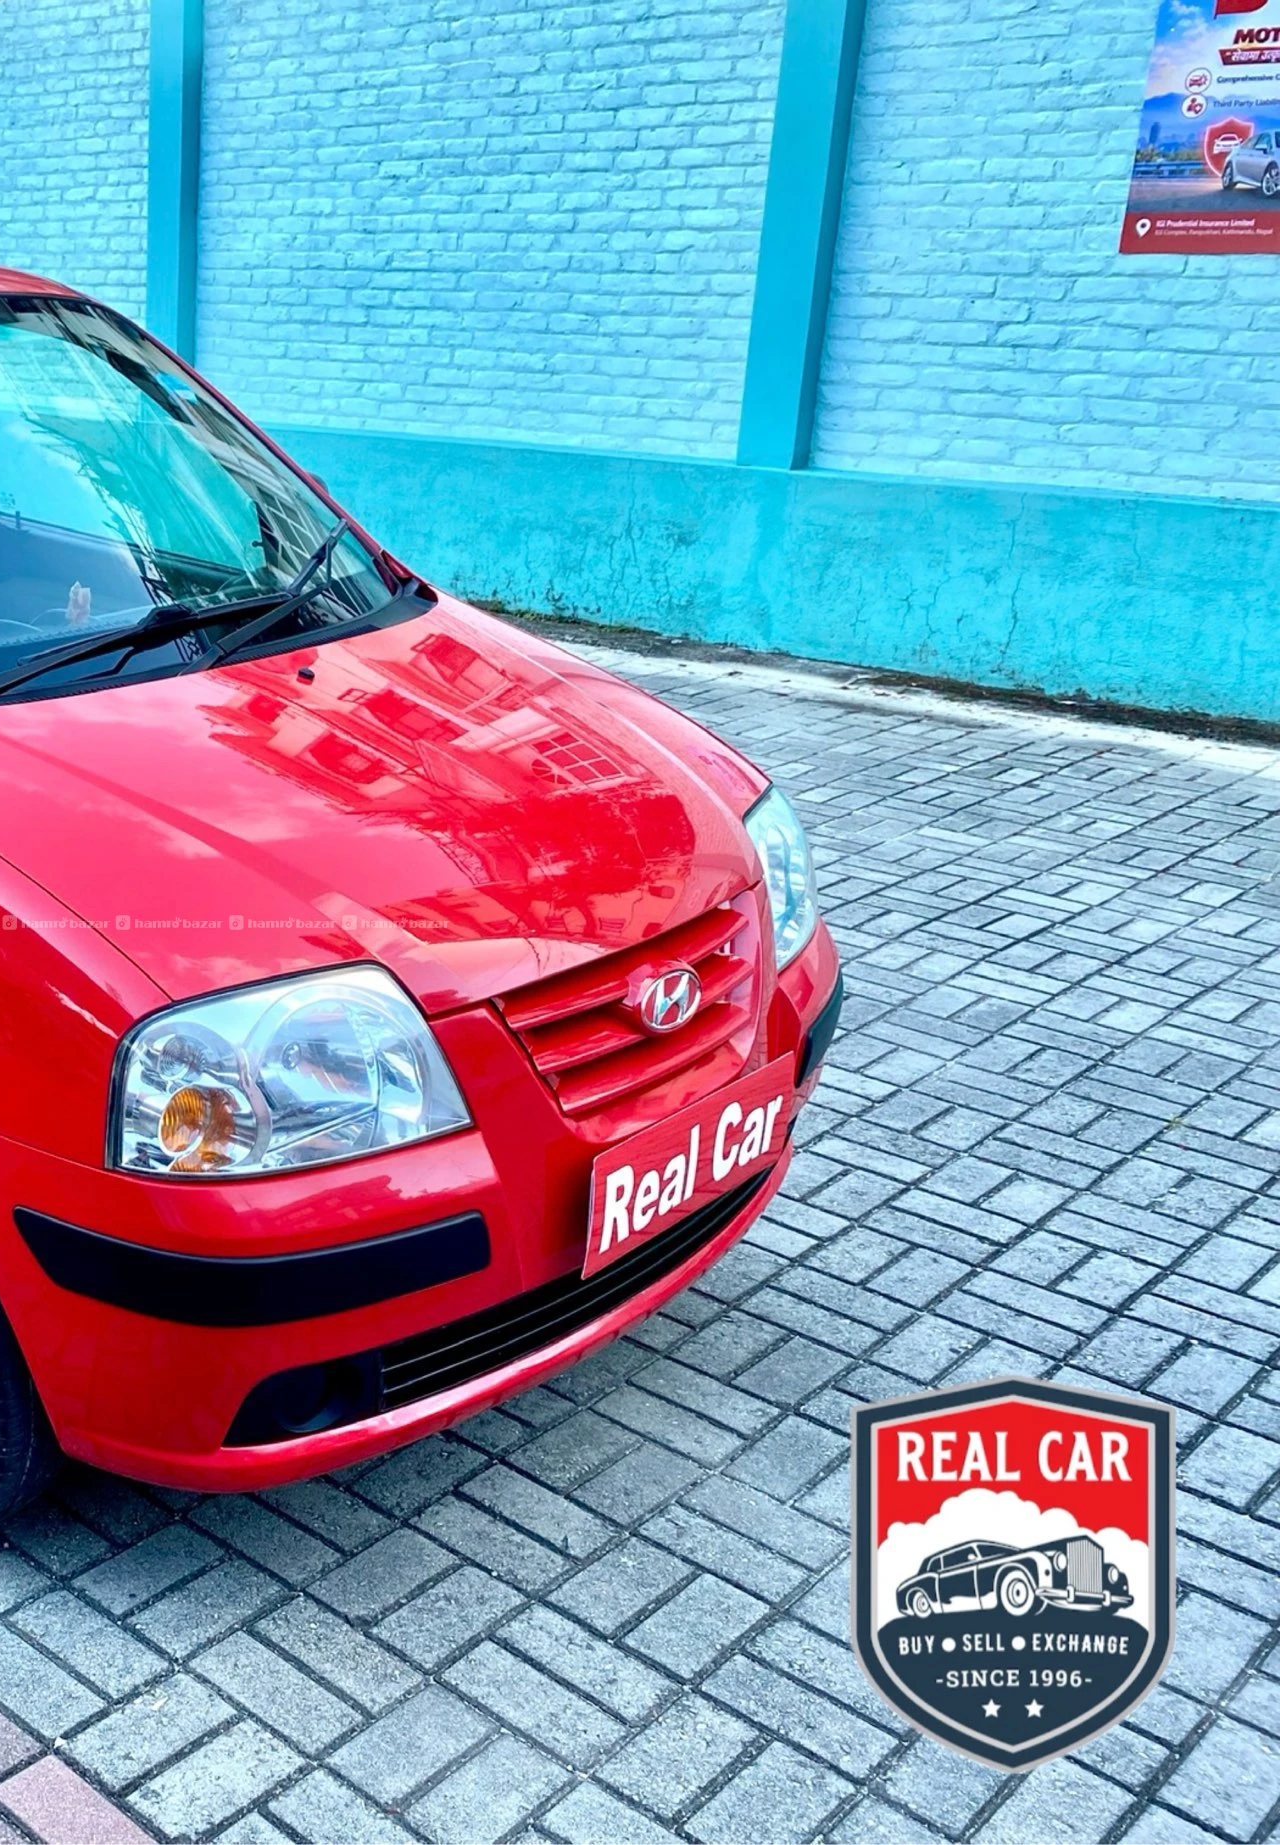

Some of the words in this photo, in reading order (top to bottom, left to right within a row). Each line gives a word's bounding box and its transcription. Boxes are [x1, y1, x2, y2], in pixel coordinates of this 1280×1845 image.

[1216, 73, 1274, 85] Comprehensive
[1213, 100, 1232, 108] Third
[1234, 99, 1253, 108] Party
[1199, 219, 1229, 228] Insurance
[1230, 218, 1255, 227] Limited
[599, 1124, 701, 1255] Real
[712, 1095, 783, 1182] Car
